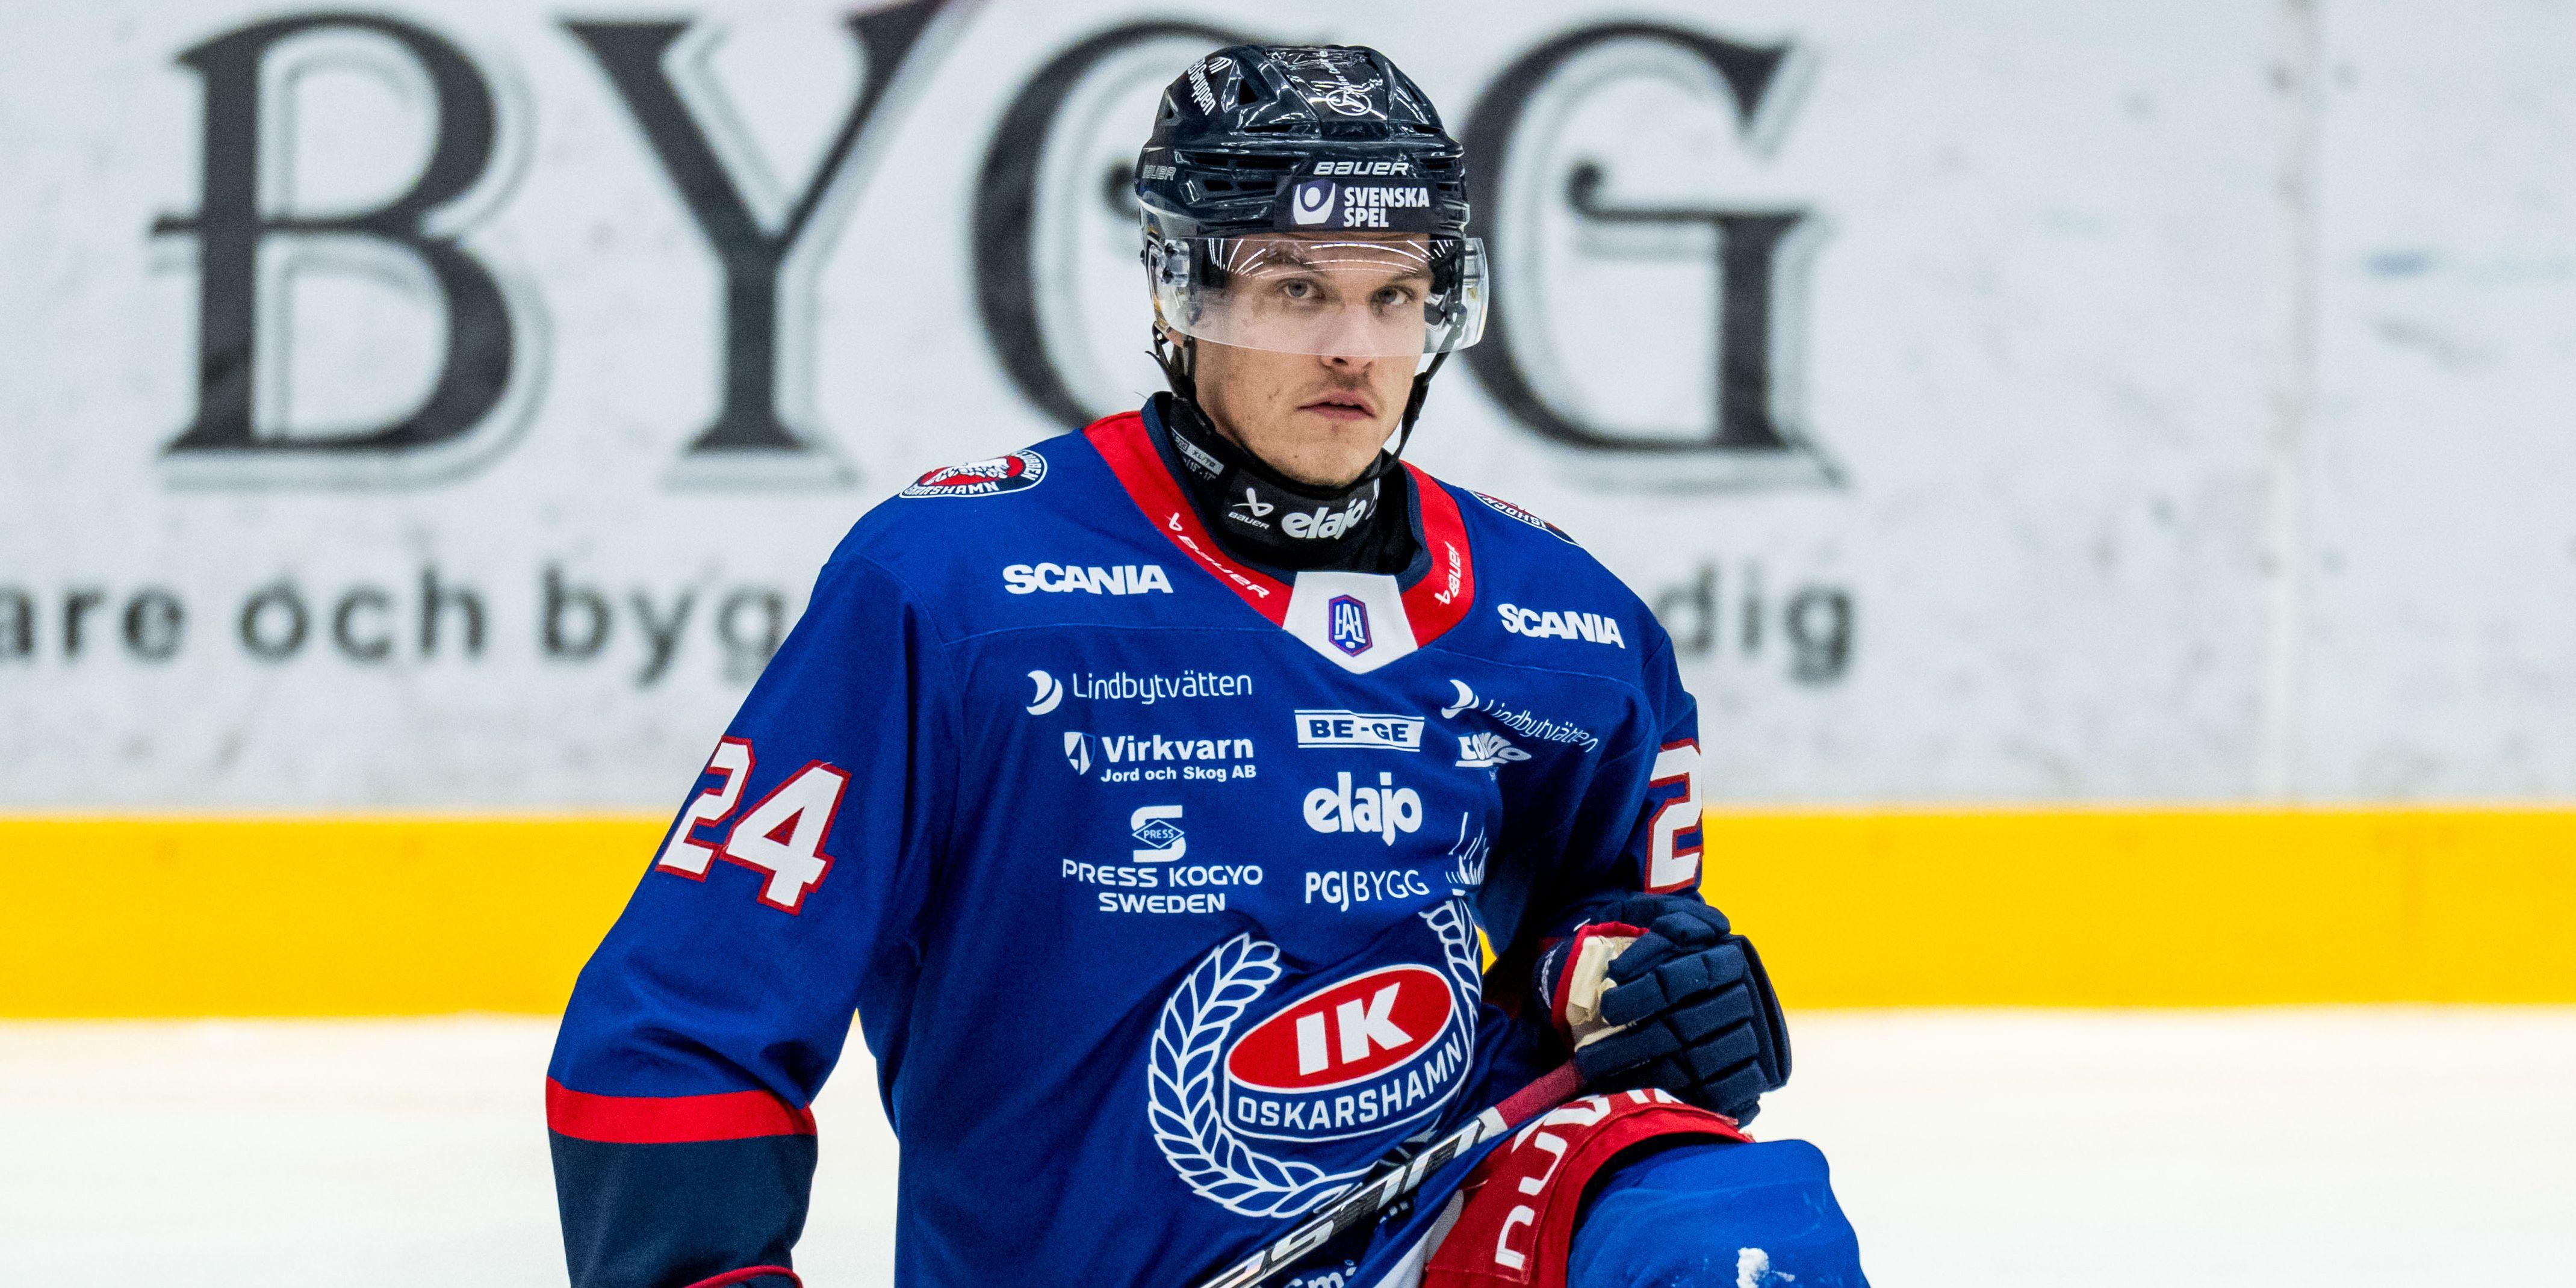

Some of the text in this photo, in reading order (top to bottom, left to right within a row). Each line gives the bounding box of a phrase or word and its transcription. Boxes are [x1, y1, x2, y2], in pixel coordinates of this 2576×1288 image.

[1314, 161, 1409, 176] BAUER
[1343, 187, 1430, 208] SVENSKA
[1343, 208, 1389, 228] SPEL
[1228, 512, 1271, 530] BAUER
[1281, 498, 1367, 540] elajo
[1002, 562, 1174, 595] SCANIA
[1177, 534, 1270, 598] BAUER
[238, 557, 489, 665] och
[1497, 603, 1625, 649] SCANIA
[1073, 670, 1253, 705] Lindbytvätten
[1483, 699, 1598, 753] Lindbytvätten
[1101, 734, 1255, 763] Virkvarn
[1100, 764, 1257, 782] Jord och Skog AB
[654, 734, 852, 917] 24
[1303, 771, 1423, 847] elajo
[1144, 828, 1175, 840] PRESS
[1062, 858, 1264, 888] PRESS KOGYO
[1098, 891, 1226, 914] SWEDEN
[1296, 982, 1413, 1077] IK
[1237, 1030, 1464, 1132] OSKARSHAMN
